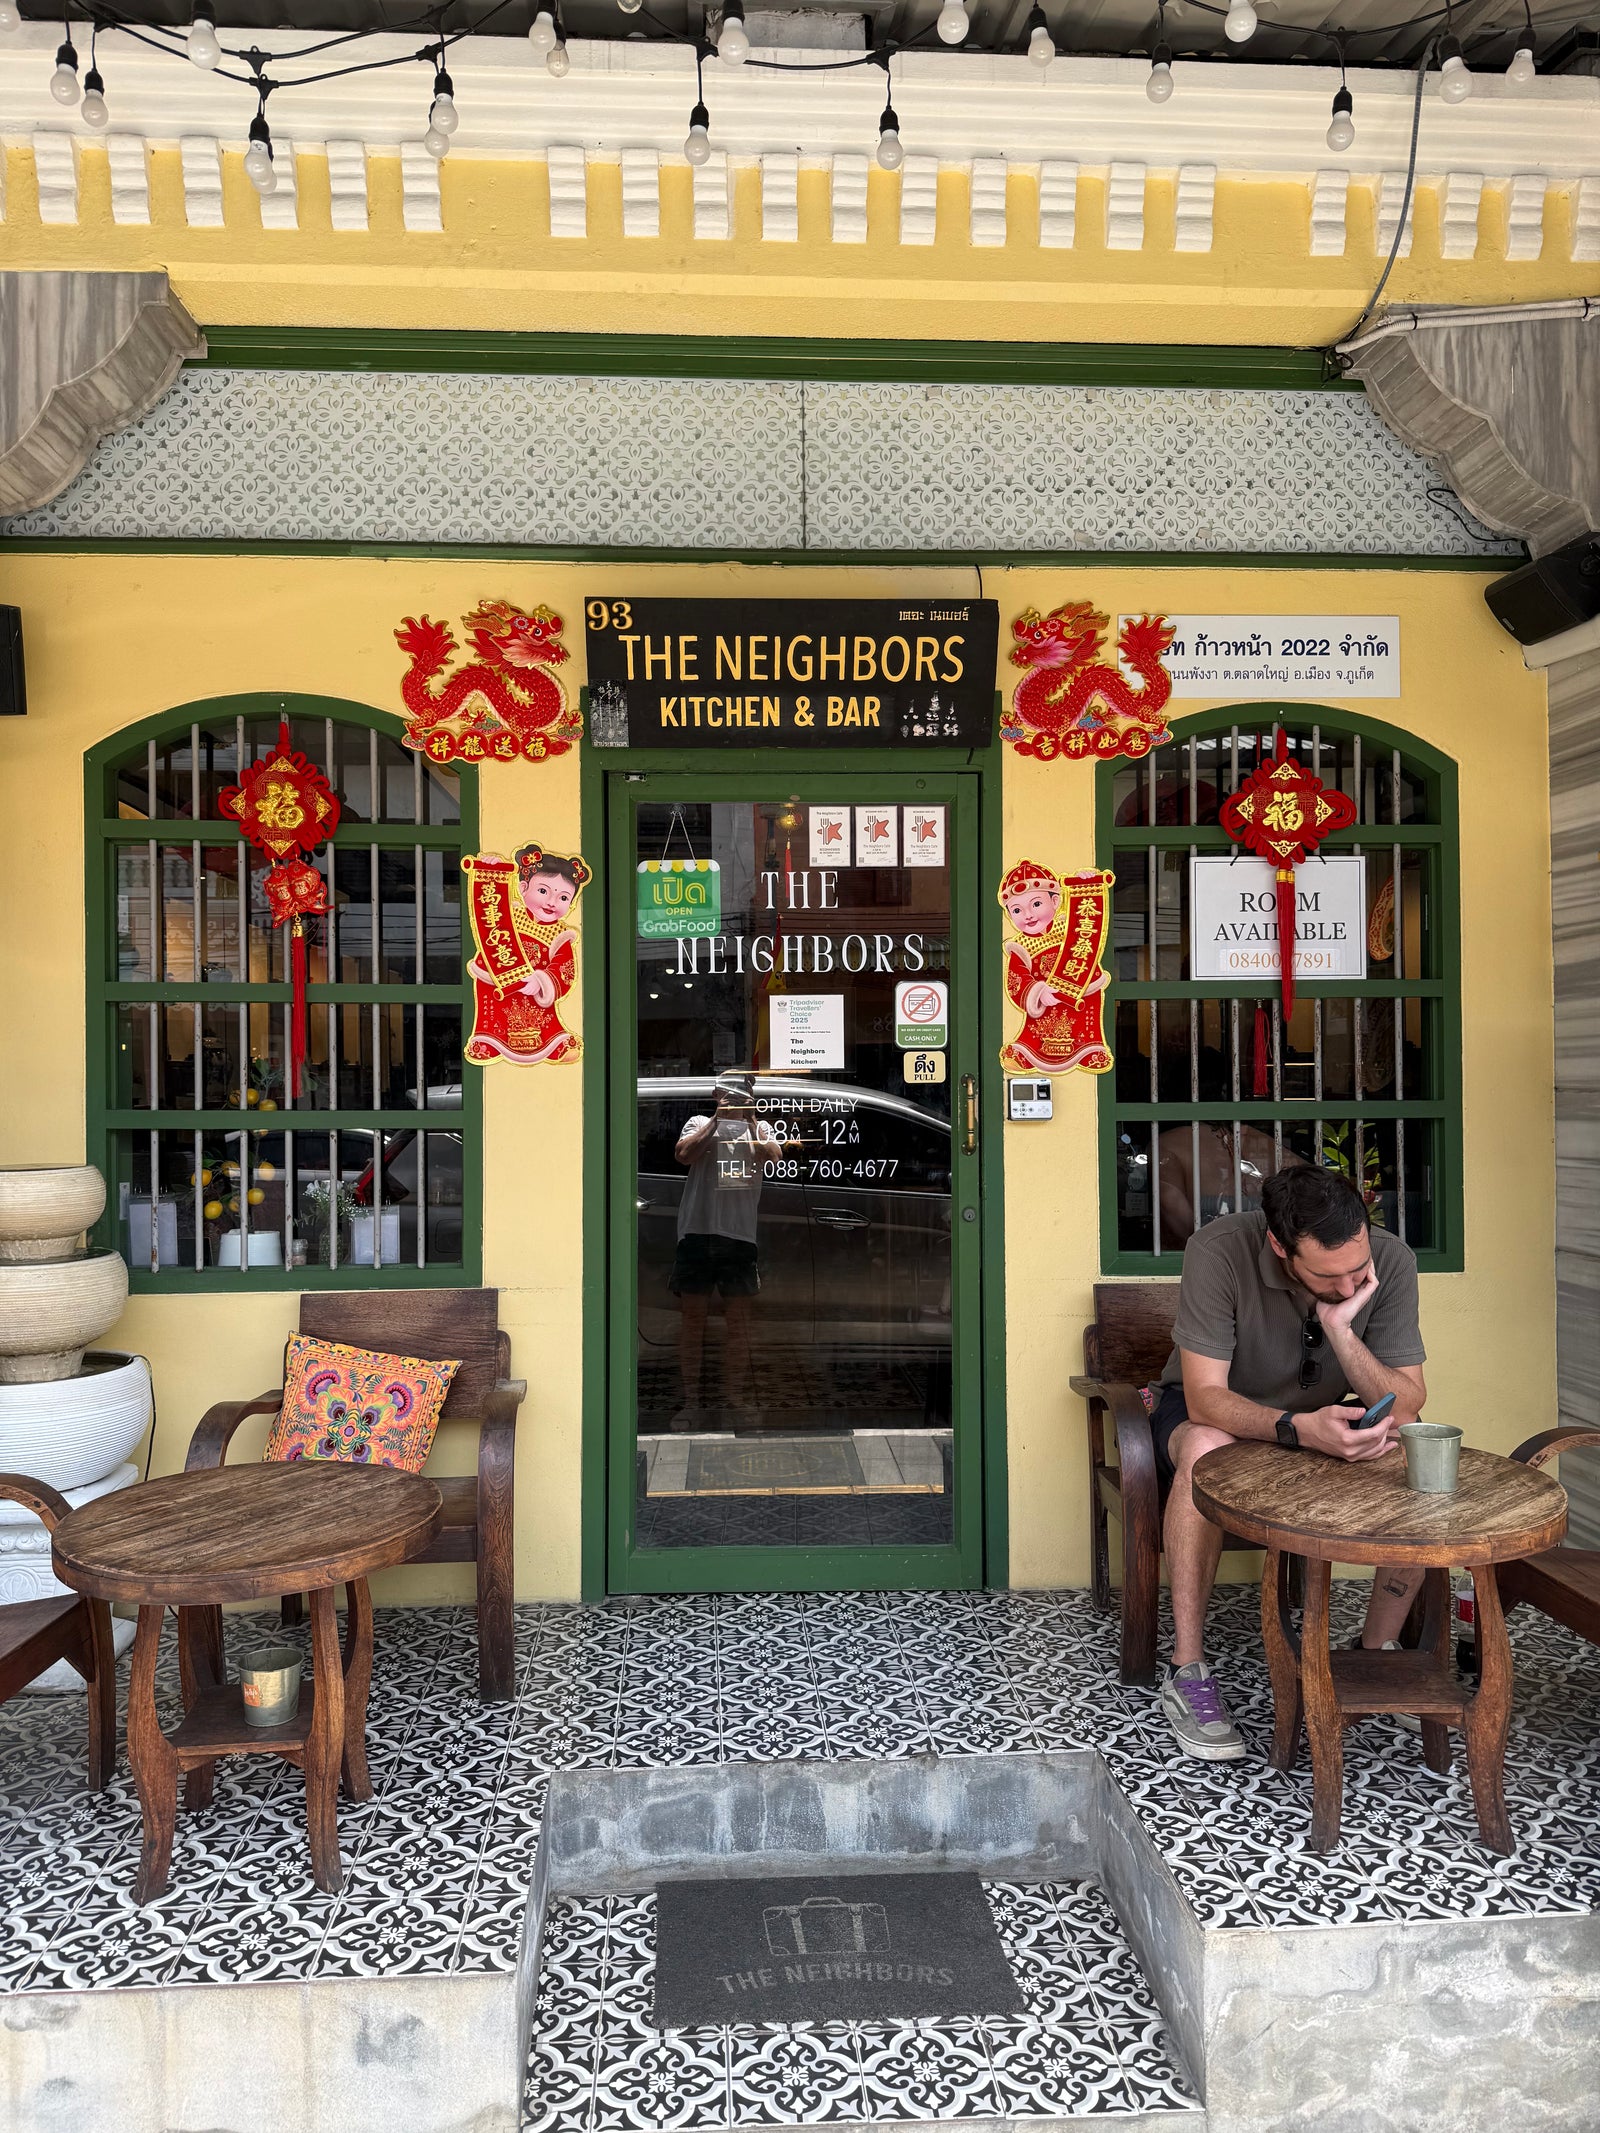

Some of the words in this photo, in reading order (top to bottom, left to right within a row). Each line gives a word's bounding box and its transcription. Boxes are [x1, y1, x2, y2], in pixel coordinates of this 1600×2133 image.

[586, 601, 633, 630] 93
[1195, 633, 1272, 656] ก้าวหน้า
[1281, 639, 1330, 656] 2022
[1339, 633, 1389, 656] จำกัด
[618, 636, 699, 681] THE
[715, 635, 965, 683] NEIGHBORS
[1167, 667, 1218, 681] นนพังงา
[1223, 664, 1289, 683] ต.ตลาดใหญ่
[1294, 665, 1331, 680] อ.เมือง
[1336, 666, 1374, 685] จ.ภูเก็ต
[660, 697, 780, 727] KITCHEN
[794, 696, 815, 726] &
[827, 697, 881, 727] BAR
[430, 735, 547, 758] 祥龍送福
[1036, 731, 1146, 757] 吉祥如意
[1262, 791, 1304, 832] 福
[653, 877, 706, 905] เปิด
[761, 871, 839, 910] THE
[1239, 891, 1321, 913] ROM
[665, 907, 693, 916] OPEN
[479, 884, 518, 968] 萬事如意
[643, 918, 716, 933] GrabFood
[1062, 898, 1102, 982] 恭喜發財
[675, 933, 925, 975] NEIGHBORS
[1229, 952, 1333, 969] 084007891
[914, 1053, 935, 1073] ดึง
[756, 1098, 803, 1113] OPEN
[810, 1098, 859, 1113] DAILY
[716, 1160, 757, 1178] TEL:
[763, 1159, 899, 1178] 088-760-4677
[716, 1967, 775, 1994] THE
[785, 1962, 953, 1986] NEIGHBORS
